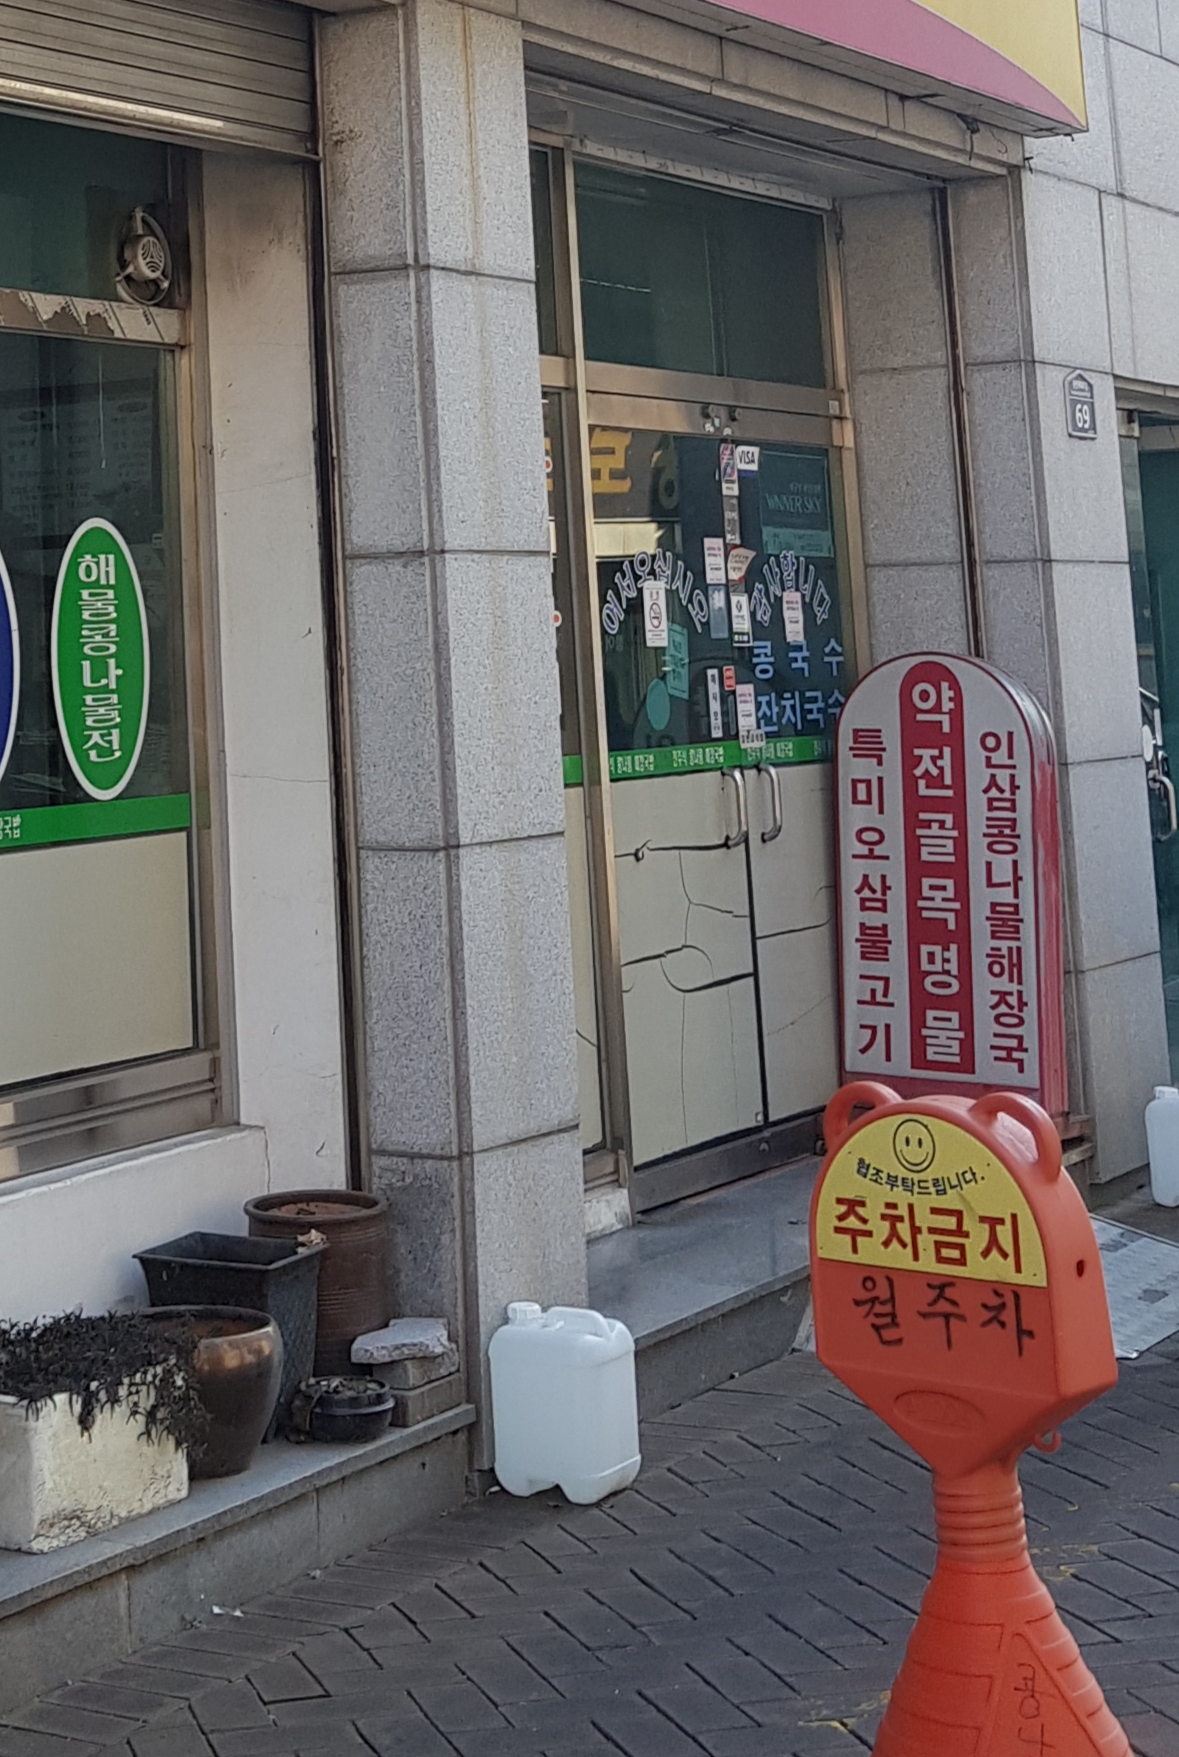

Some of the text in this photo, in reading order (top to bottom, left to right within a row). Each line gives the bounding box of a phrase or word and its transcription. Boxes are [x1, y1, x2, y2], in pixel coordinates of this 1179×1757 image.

[1075, 403, 1090, 429] 69
[738, 449, 756, 466] VISA
[602, 548, 709, 633] 어서오십시오
[750, 550, 831, 627] 감사합니다
[77, 553, 123, 763] 해물콩나물전
[752, 638, 844, 679] 콩국수
[757, 689, 845, 734] 잔치국수
[848, 727, 896, 1063] 특미오삼불고기
[979, 730, 1029, 1074] 인삼콩나물해장국
[833, 1196, 1023, 1274] 주차금지
